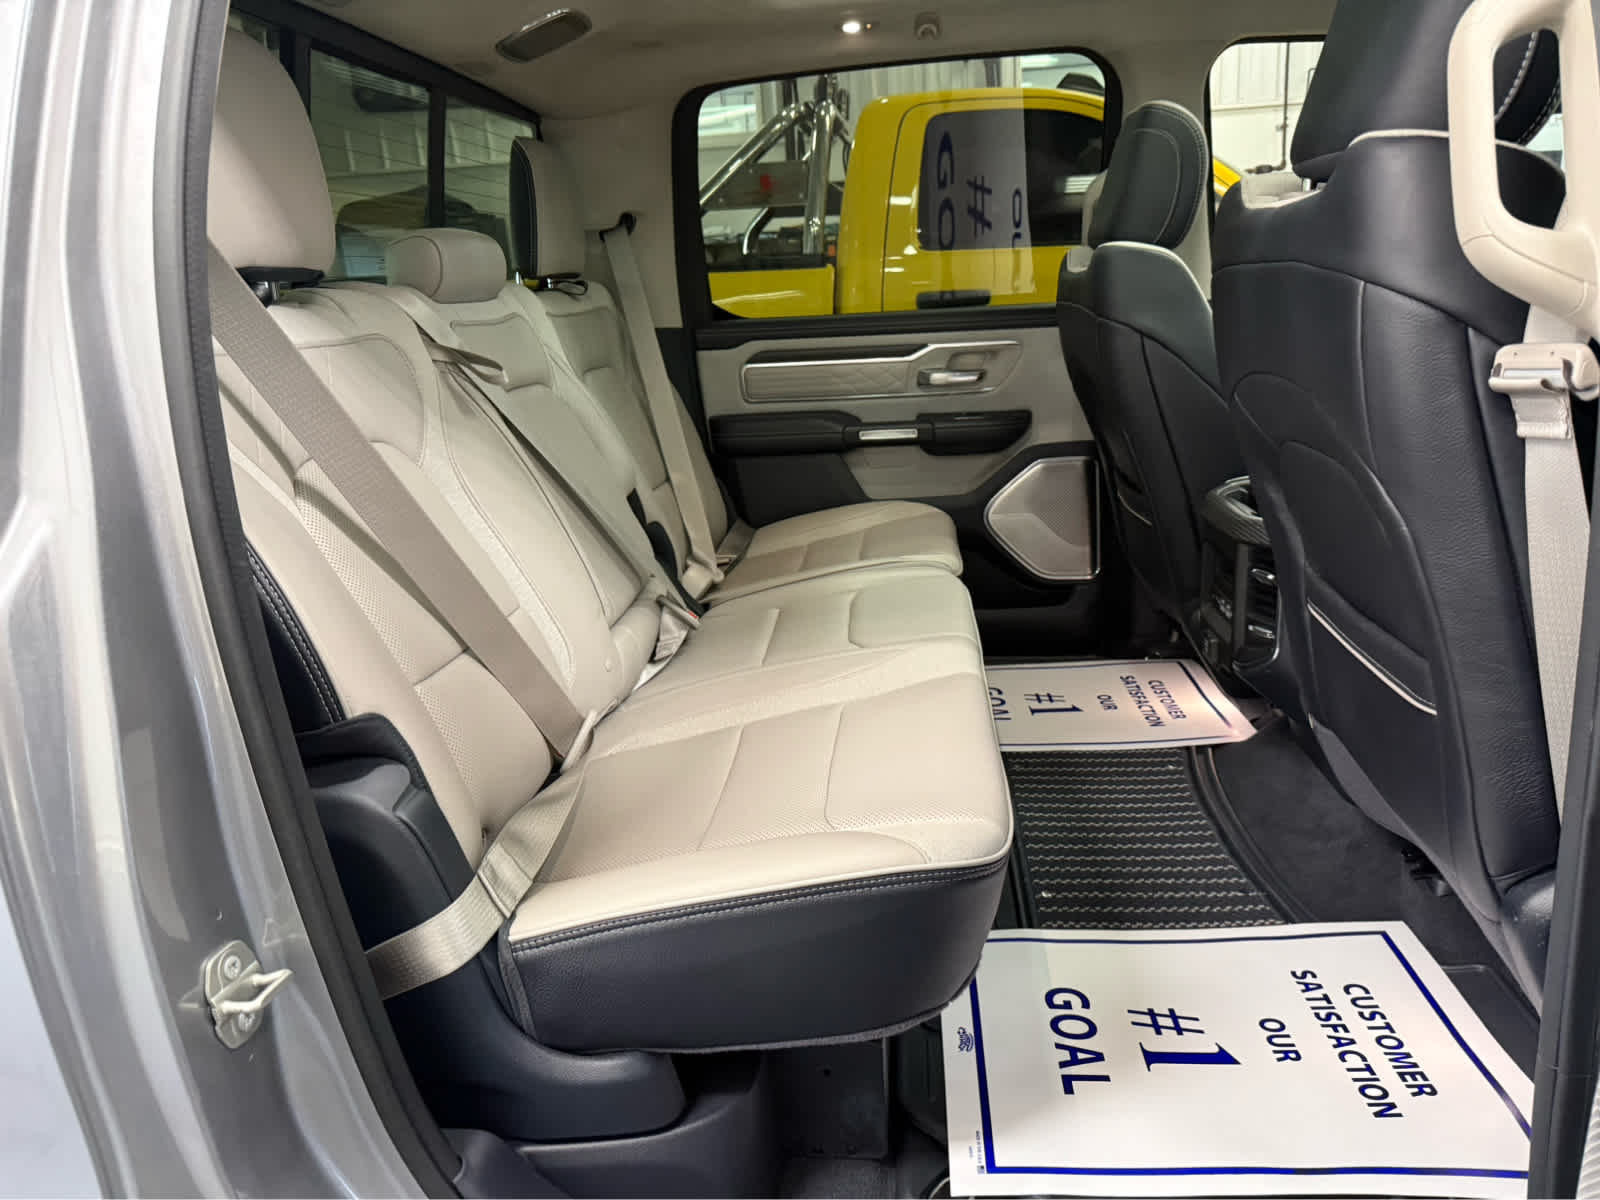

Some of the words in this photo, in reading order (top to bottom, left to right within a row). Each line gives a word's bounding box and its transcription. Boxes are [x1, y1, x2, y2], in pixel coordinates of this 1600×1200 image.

[1024, 692, 1083, 716] #1
[1097, 694, 1118, 711] OUR
[1120, 675, 1166, 728] SATISFACTION
[1148, 679, 1187, 720] CUSTOMER
[1044, 987, 1111, 1095] GOAL
[1127, 1007, 1241, 1072] #1
[1258, 1017, 1302, 1063] OUR
[1290, 969, 1404, 1119] SATISFACTION
[1343, 983, 1438, 1098] CUSTOMER
